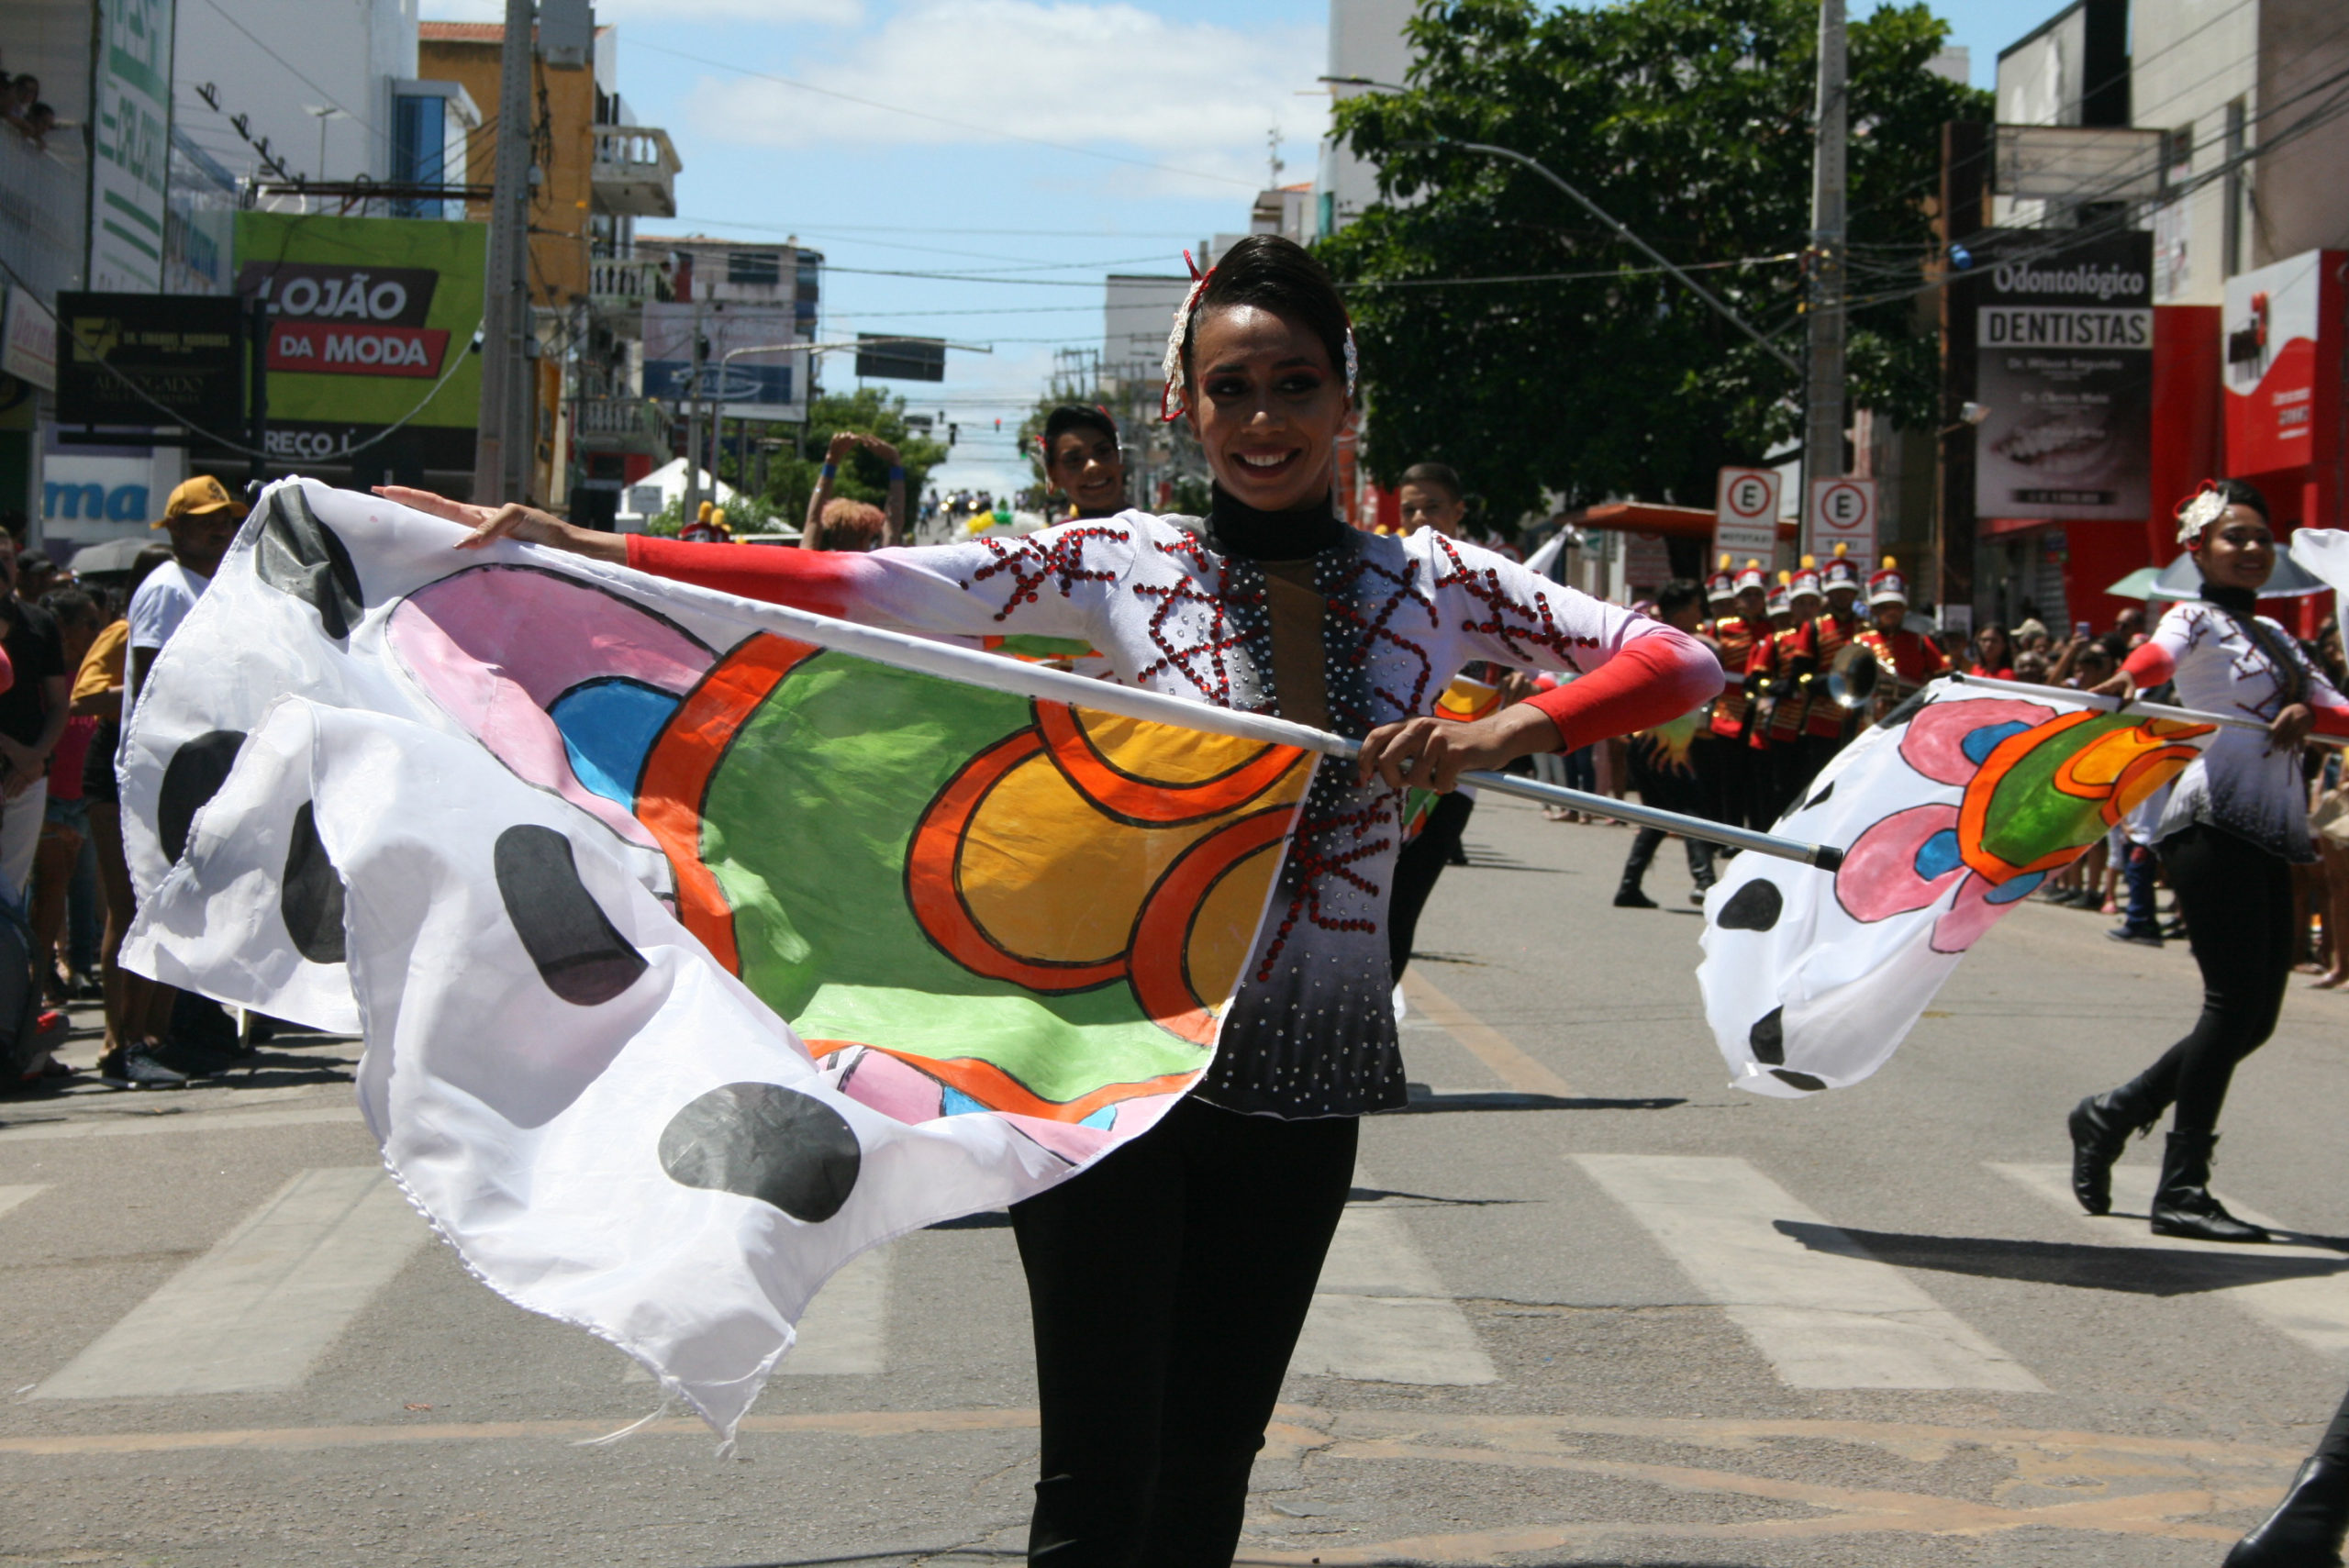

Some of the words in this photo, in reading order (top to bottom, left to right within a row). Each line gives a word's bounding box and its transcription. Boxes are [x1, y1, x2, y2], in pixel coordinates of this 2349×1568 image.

[259, 273, 407, 320] LOJÃO
[1993, 262, 2144, 300] Odontológico
[1988, 312, 2145, 345] DENTISTAS
[279, 336, 314, 358] DA
[324, 334, 429, 366] MODA
[246, 429, 334, 459] REÇO
[43, 482, 149, 523] ma
[1742, 484, 1758, 507] E
[1836, 495, 1851, 517] E
